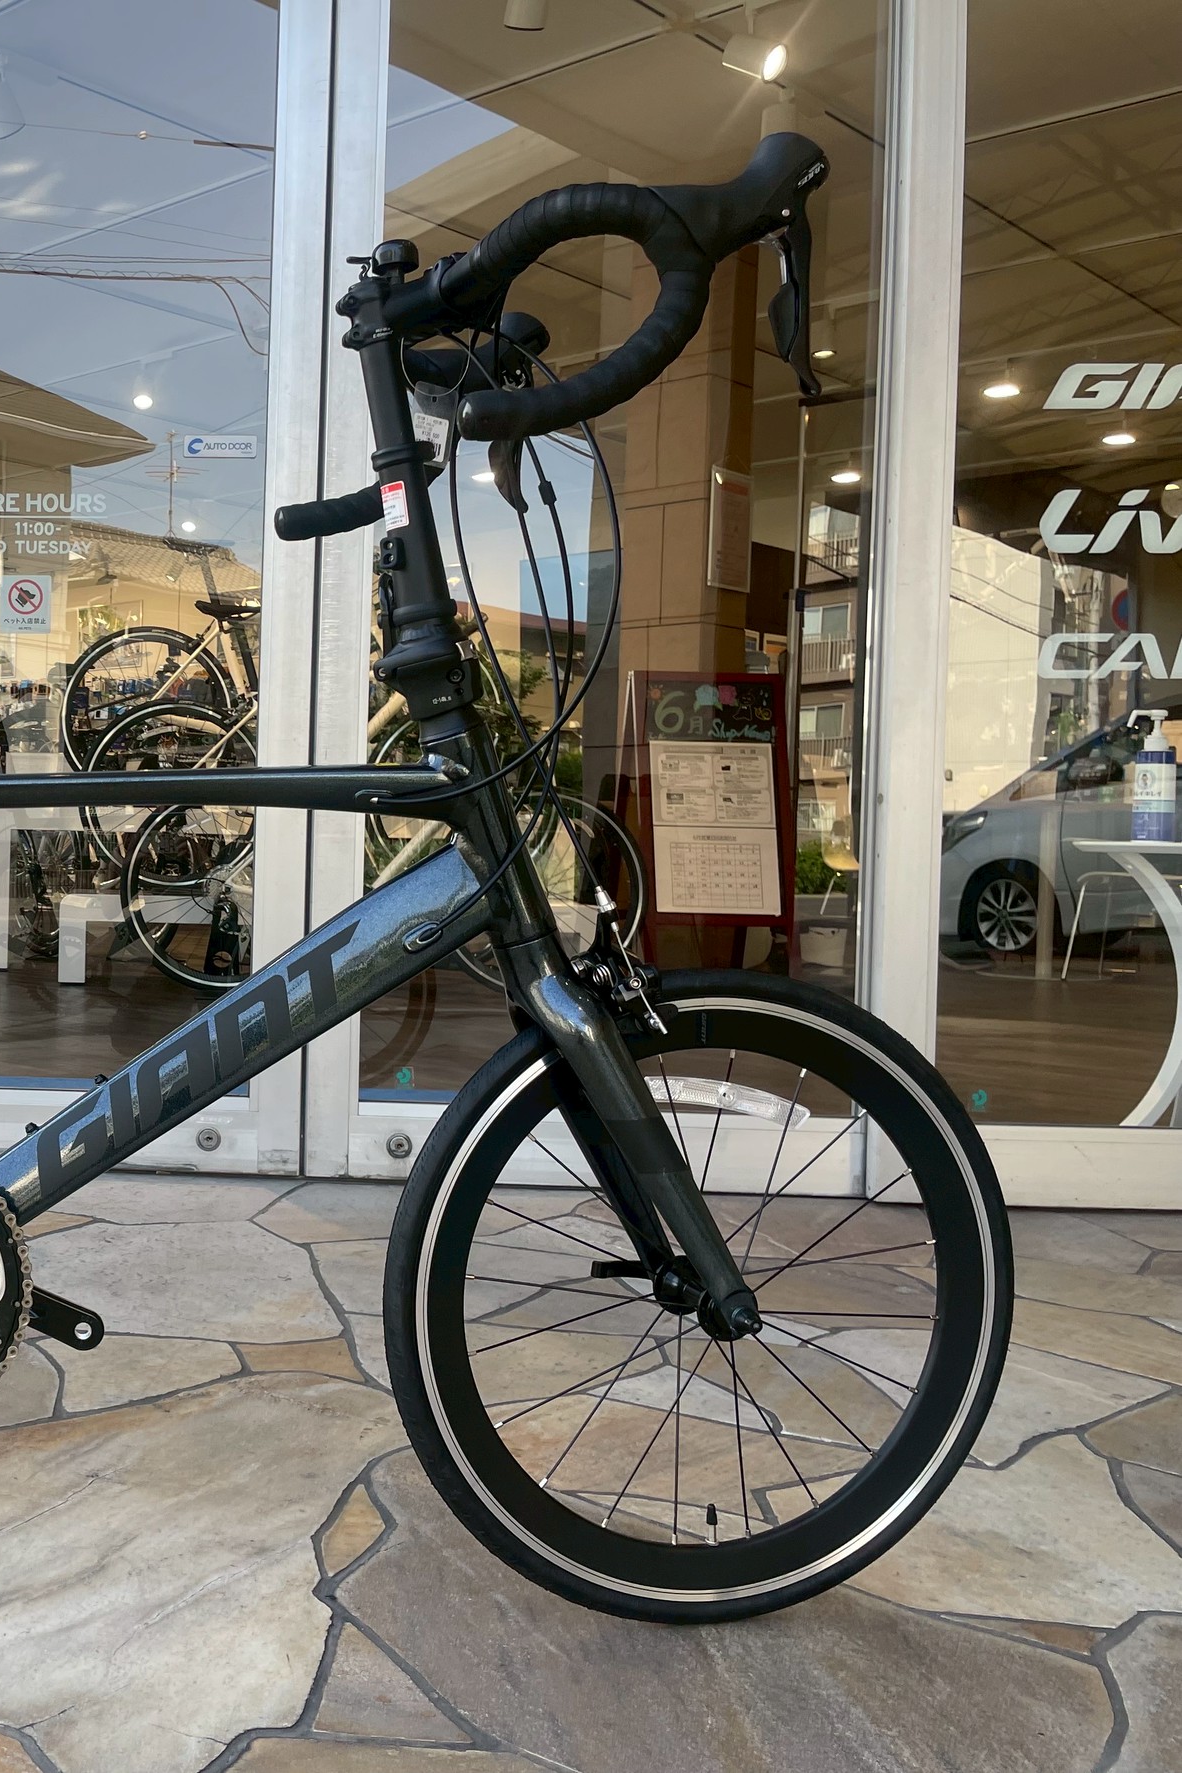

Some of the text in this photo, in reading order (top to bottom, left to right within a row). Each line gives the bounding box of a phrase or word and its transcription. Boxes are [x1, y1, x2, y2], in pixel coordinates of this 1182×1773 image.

[203, 442, 253, 451] AUTO DOOR
[25, 492, 108, 513] HOURS
[14, 540, 95, 555] TUESDAY
[1038, 632, 1182, 679] CA
[36, 919, 361, 1201] GIANT
